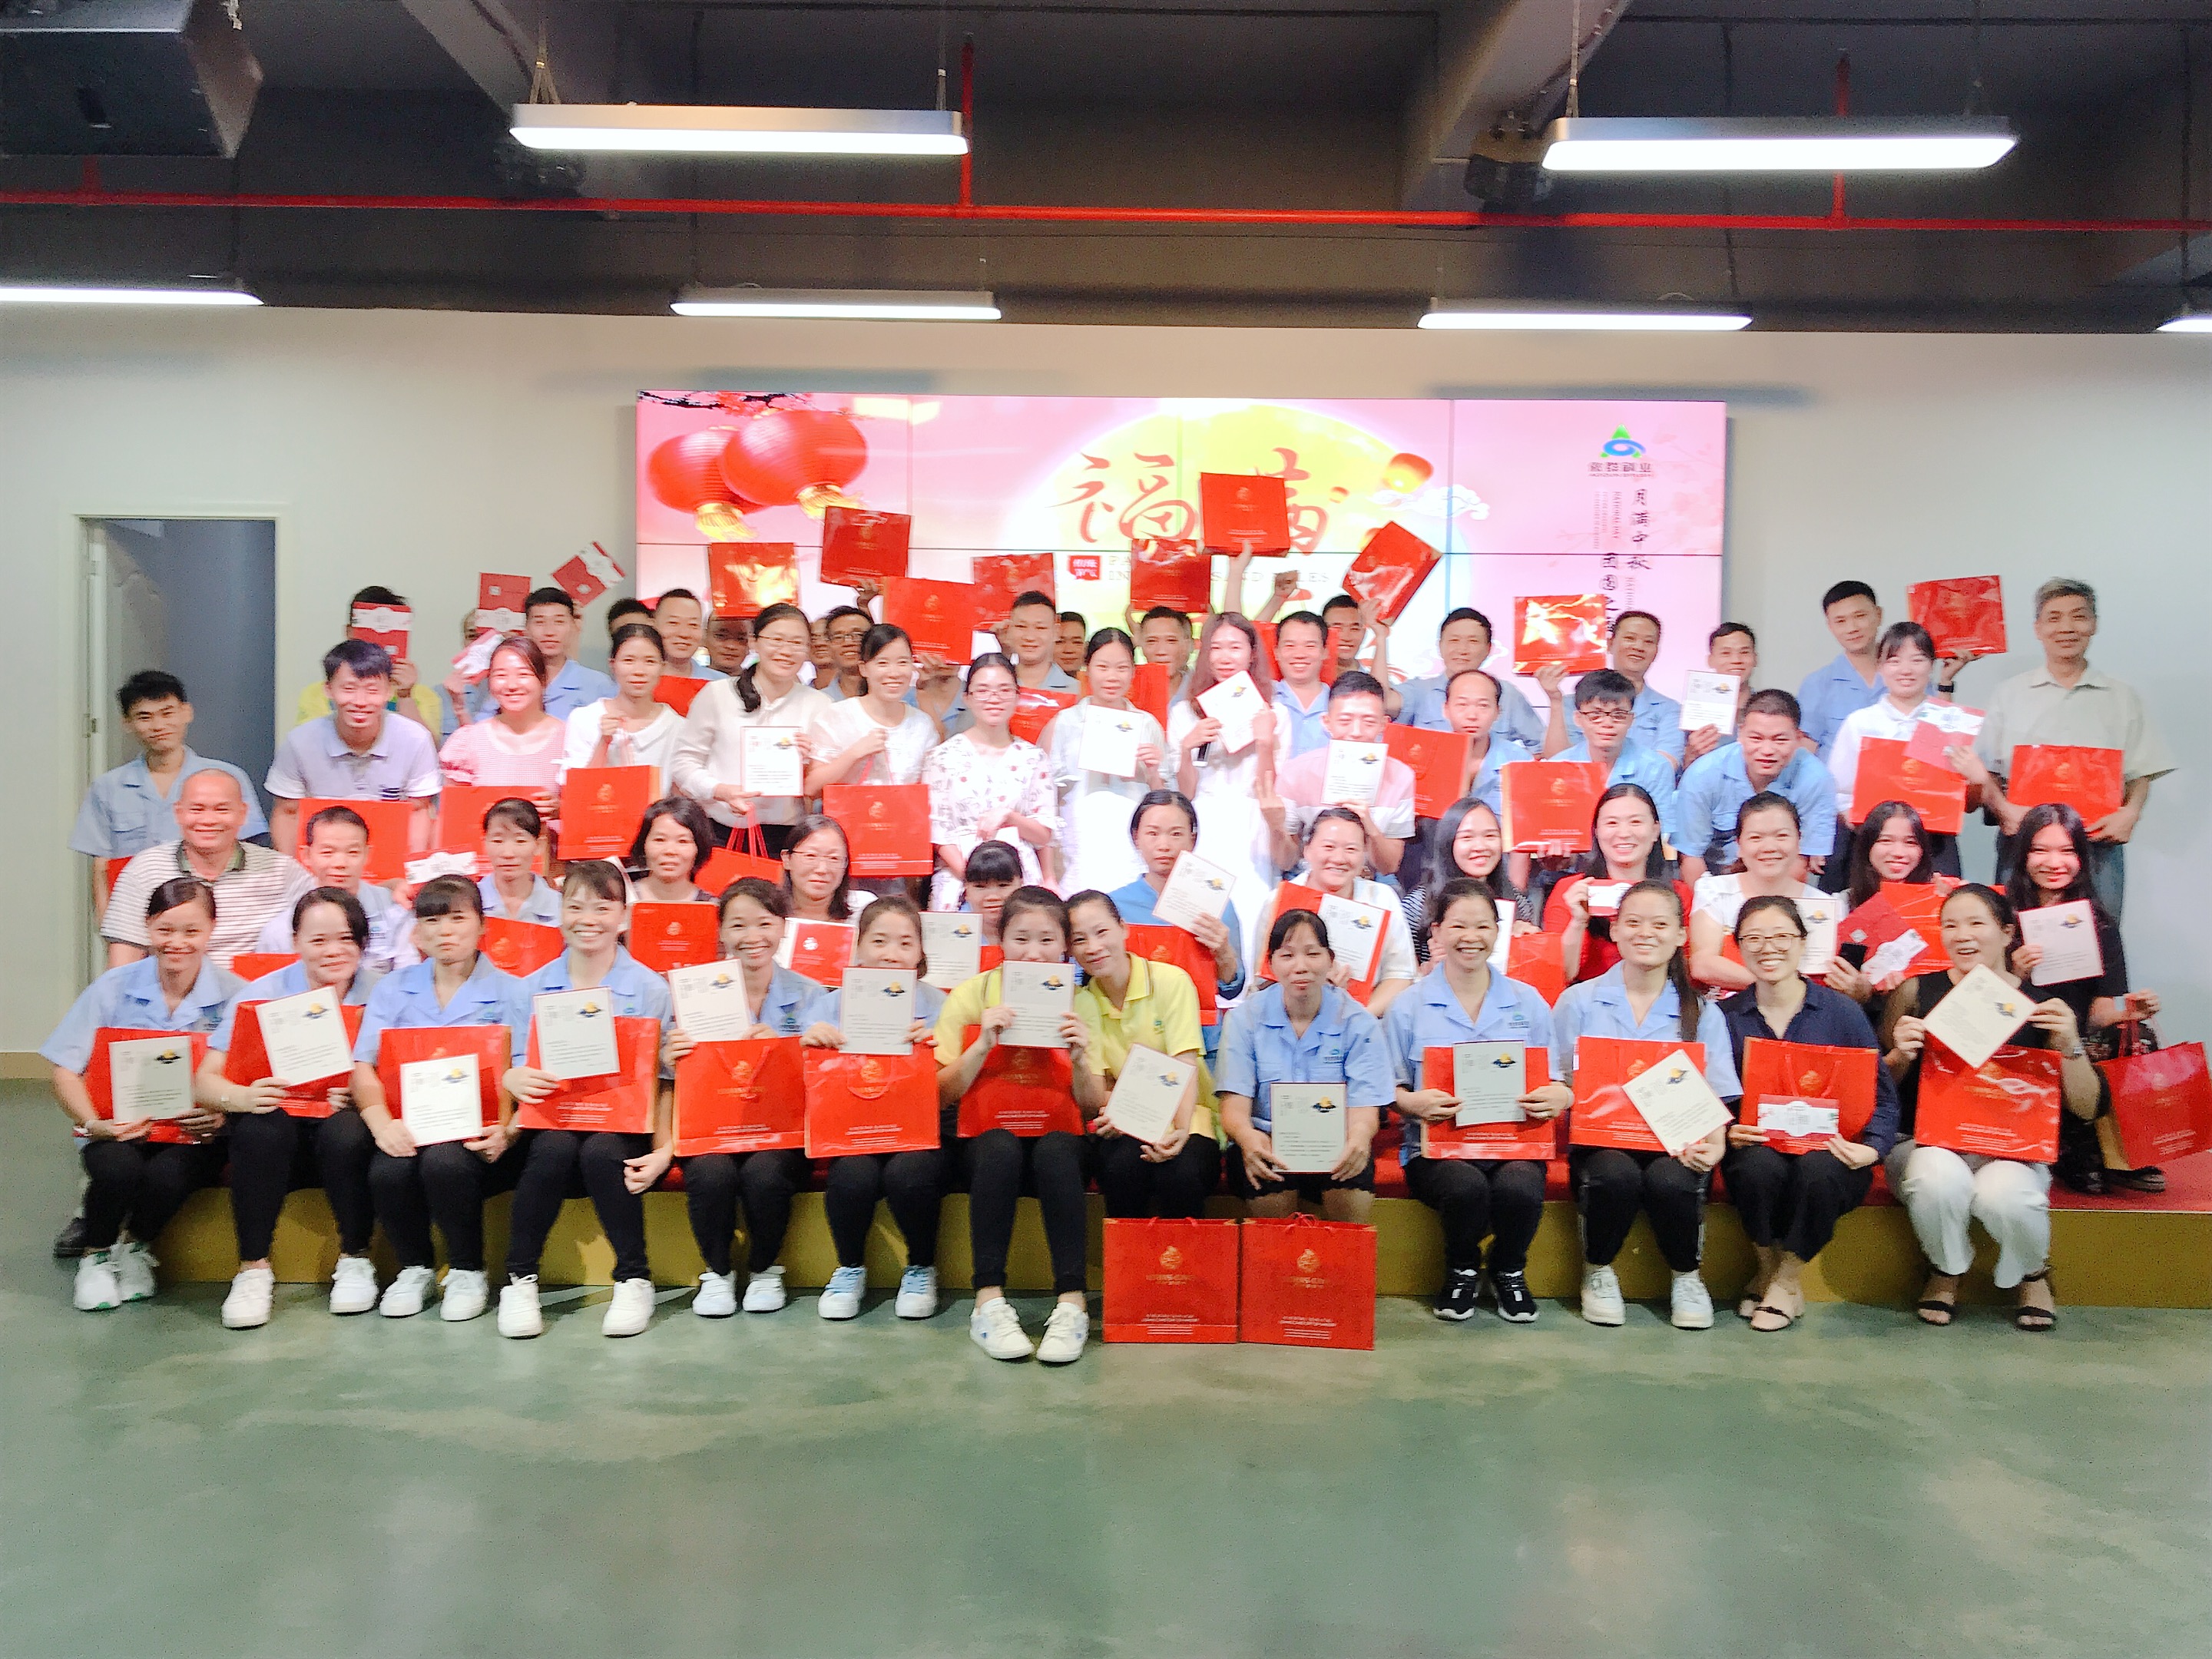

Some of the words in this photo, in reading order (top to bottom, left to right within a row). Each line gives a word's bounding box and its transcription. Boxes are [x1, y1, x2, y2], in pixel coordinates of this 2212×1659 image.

[1625, 488, 1652, 571] 月满中秋
[1625, 577, 1635, 611] NATIONA
